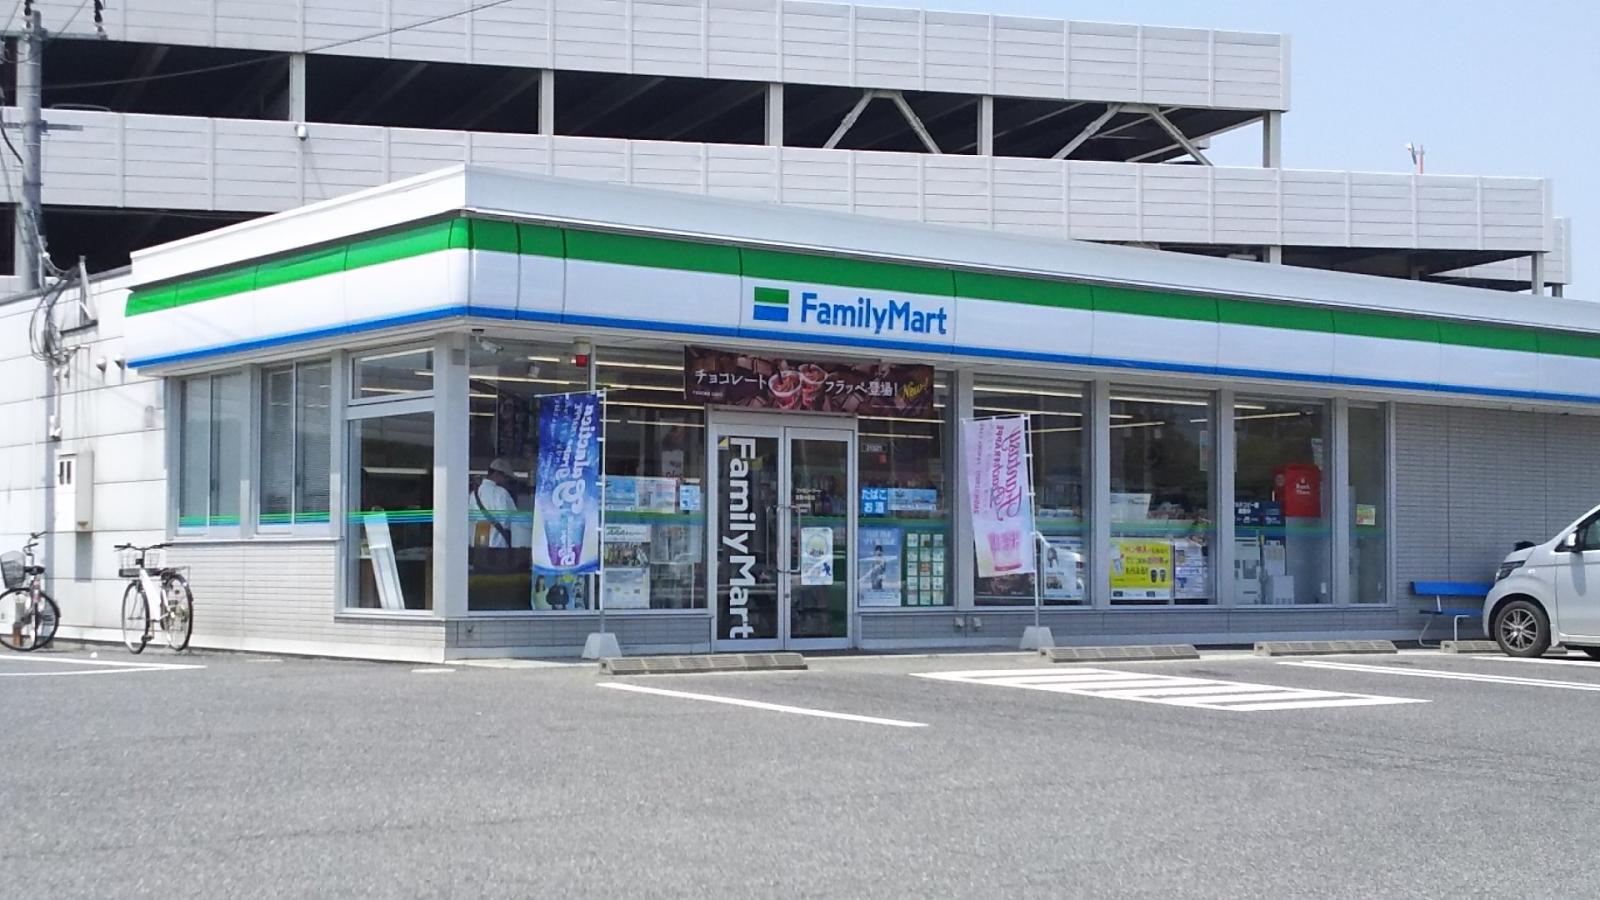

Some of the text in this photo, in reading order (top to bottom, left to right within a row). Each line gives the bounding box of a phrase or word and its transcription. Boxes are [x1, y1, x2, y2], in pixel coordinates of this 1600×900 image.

[801, 291, 947, 335] FamilyMart
[694, 368, 768, 390] チョコレート
[862, 488, 888, 501] たばこ
[722, 437, 757, 639] FamilyMart
